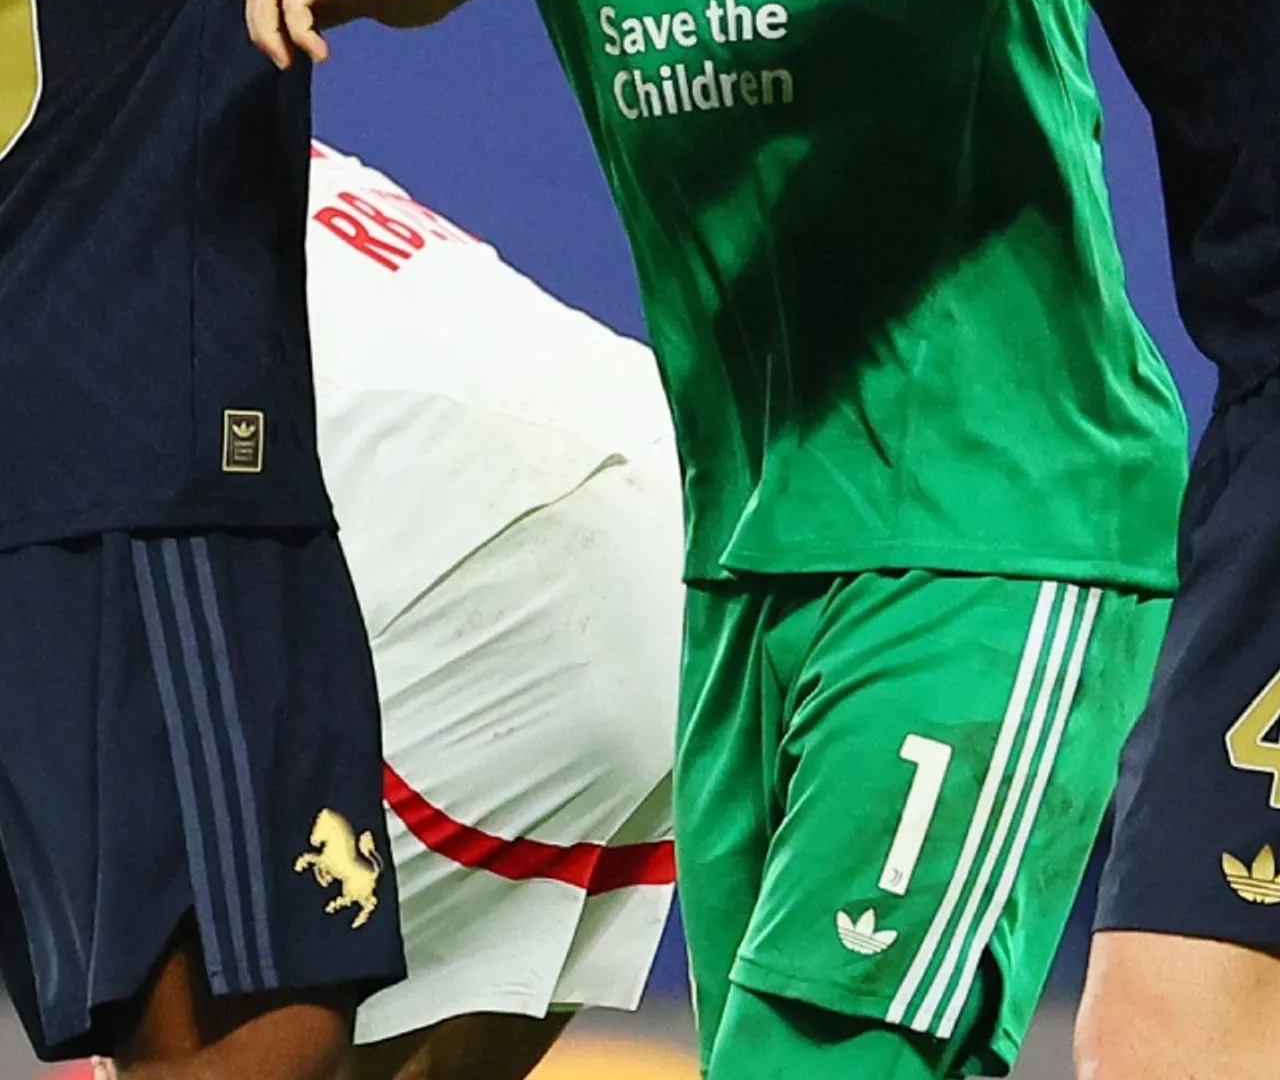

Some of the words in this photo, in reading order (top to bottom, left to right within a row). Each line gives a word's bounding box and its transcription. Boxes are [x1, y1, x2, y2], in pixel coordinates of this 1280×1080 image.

[599, 5, 697, 56] Save
[614, 60, 794, 120] Children
[313, 191, 425, 273] RB
[878, 732, 953, 897] 1
